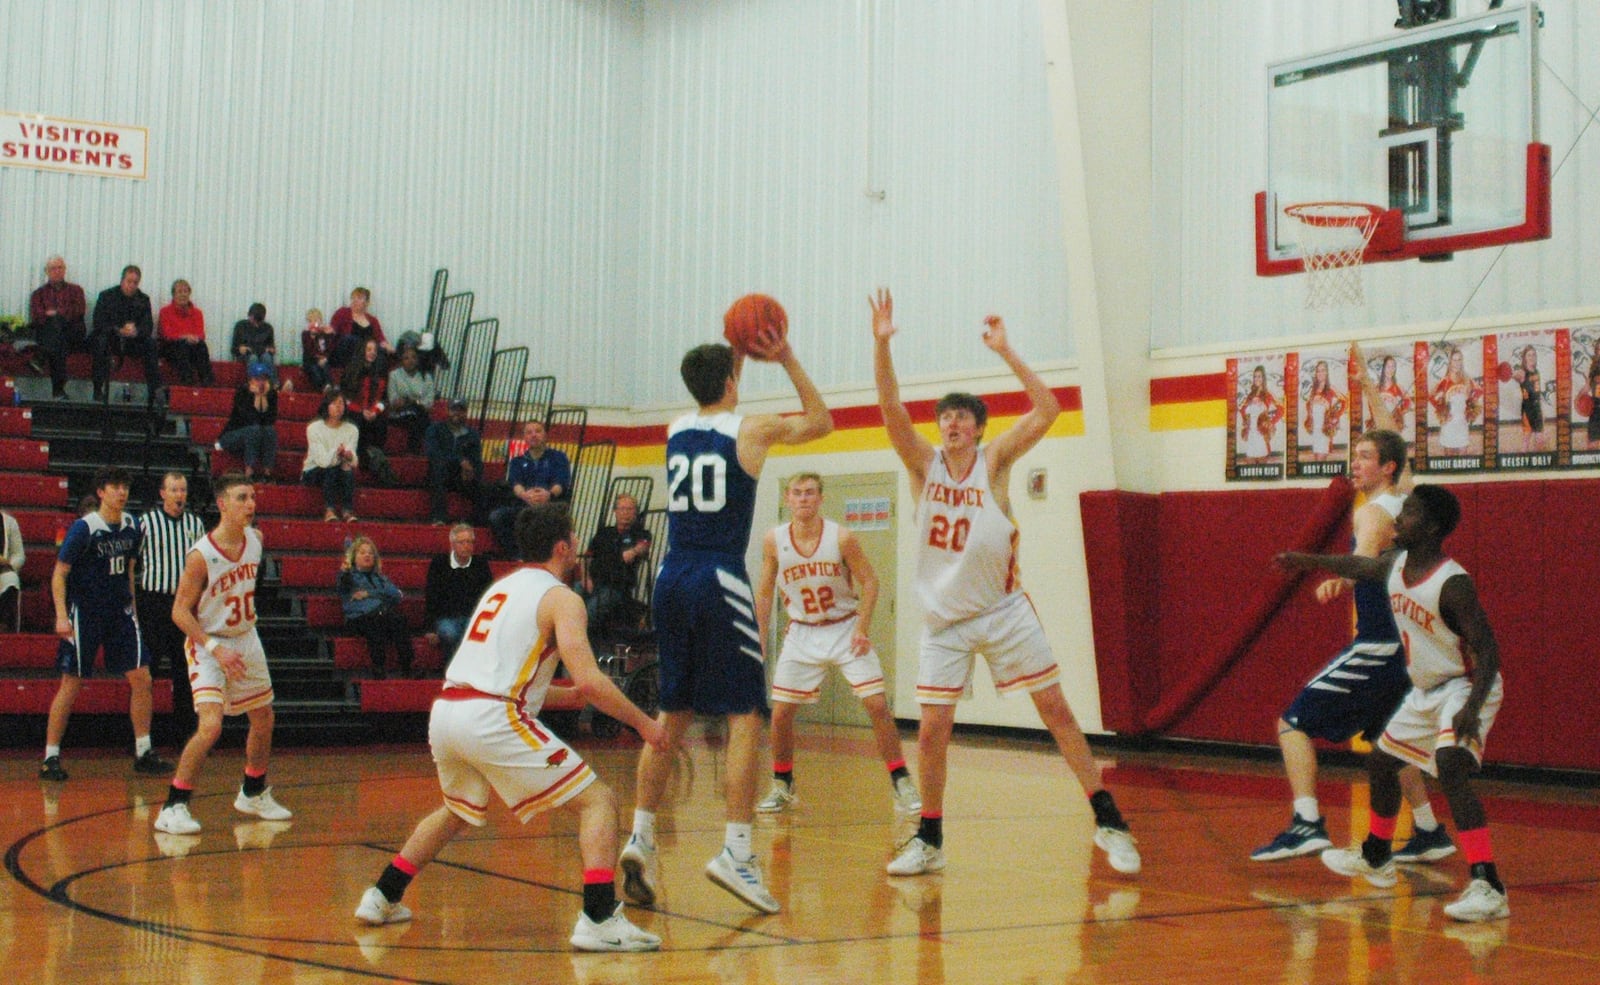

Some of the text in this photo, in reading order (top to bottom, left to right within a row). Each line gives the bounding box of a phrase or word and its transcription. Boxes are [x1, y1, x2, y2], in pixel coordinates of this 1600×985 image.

[19, 122, 119, 148] VISITOR
[2, 141, 133, 169] STUDENTS
[668, 453, 727, 513] 20
[927, 482, 984, 509] FENWICK
[929, 514, 970, 552] 20
[109, 556, 125, 575] 10
[783, 562, 841, 584] FENWICK
[225, 591, 256, 627] 30
[801, 586, 834, 614] 22
[468, 593, 507, 643] 2
